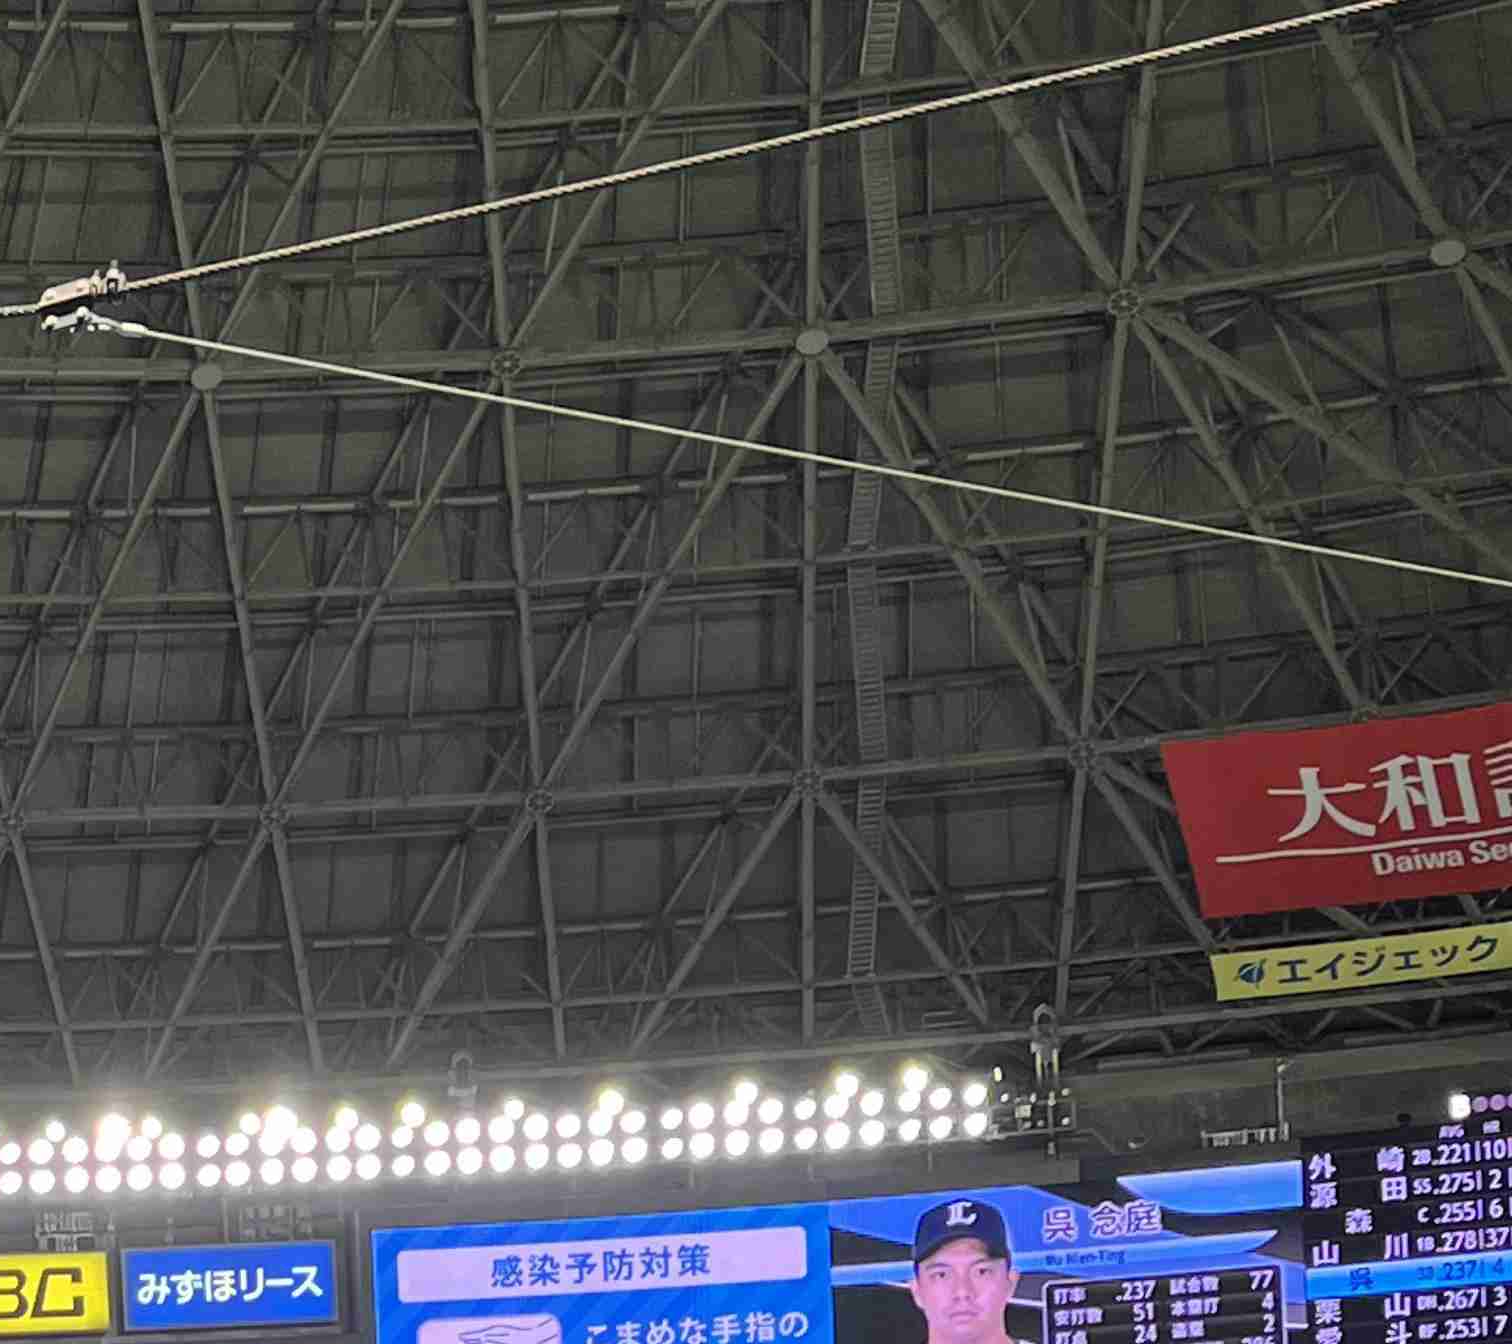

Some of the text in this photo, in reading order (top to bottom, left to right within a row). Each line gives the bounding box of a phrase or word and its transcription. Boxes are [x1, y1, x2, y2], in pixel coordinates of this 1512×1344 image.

[1372, 840, 1512, 876] Daiwa Se
[1276, 935, 1500, 984] エイジェック
[1431, 1141, 1472, 1166] .221
[1482, 1137, 1506, 1160] 10
[1413, 1177, 1432, 1195] SS
[1433, 1171, 1476, 1195] .275
[1488, 1168, 1503, 1190] 2
[1090, 1199, 1163, 1240] 念庭
[1344, 1197, 1504, 1235] 森 C .255 6
[1436, 1229, 1477, 1252] .278
[1482, 1226, 1510, 1249] 37
[489, 1244, 711, 1289] 感染予防対策
[137, 1265, 324, 1305] みずほリース
[1115, 1280, 1157, 1302] .237
[1249, 1269, 1275, 1291] 77
[1438, 1288, 1480, 1312] .267
[1493, 1286, 1507, 1306] 3
[1133, 1303, 1155, 1322] 51
[1261, 1292, 1275, 1311] 4
[1133, 1324, 1157, 1344] 24
[1262, 1313, 1276, 1333] 2
[1439, 1317, 1481, 1340] .253
[1493, 1315, 1509, 1335] 7
